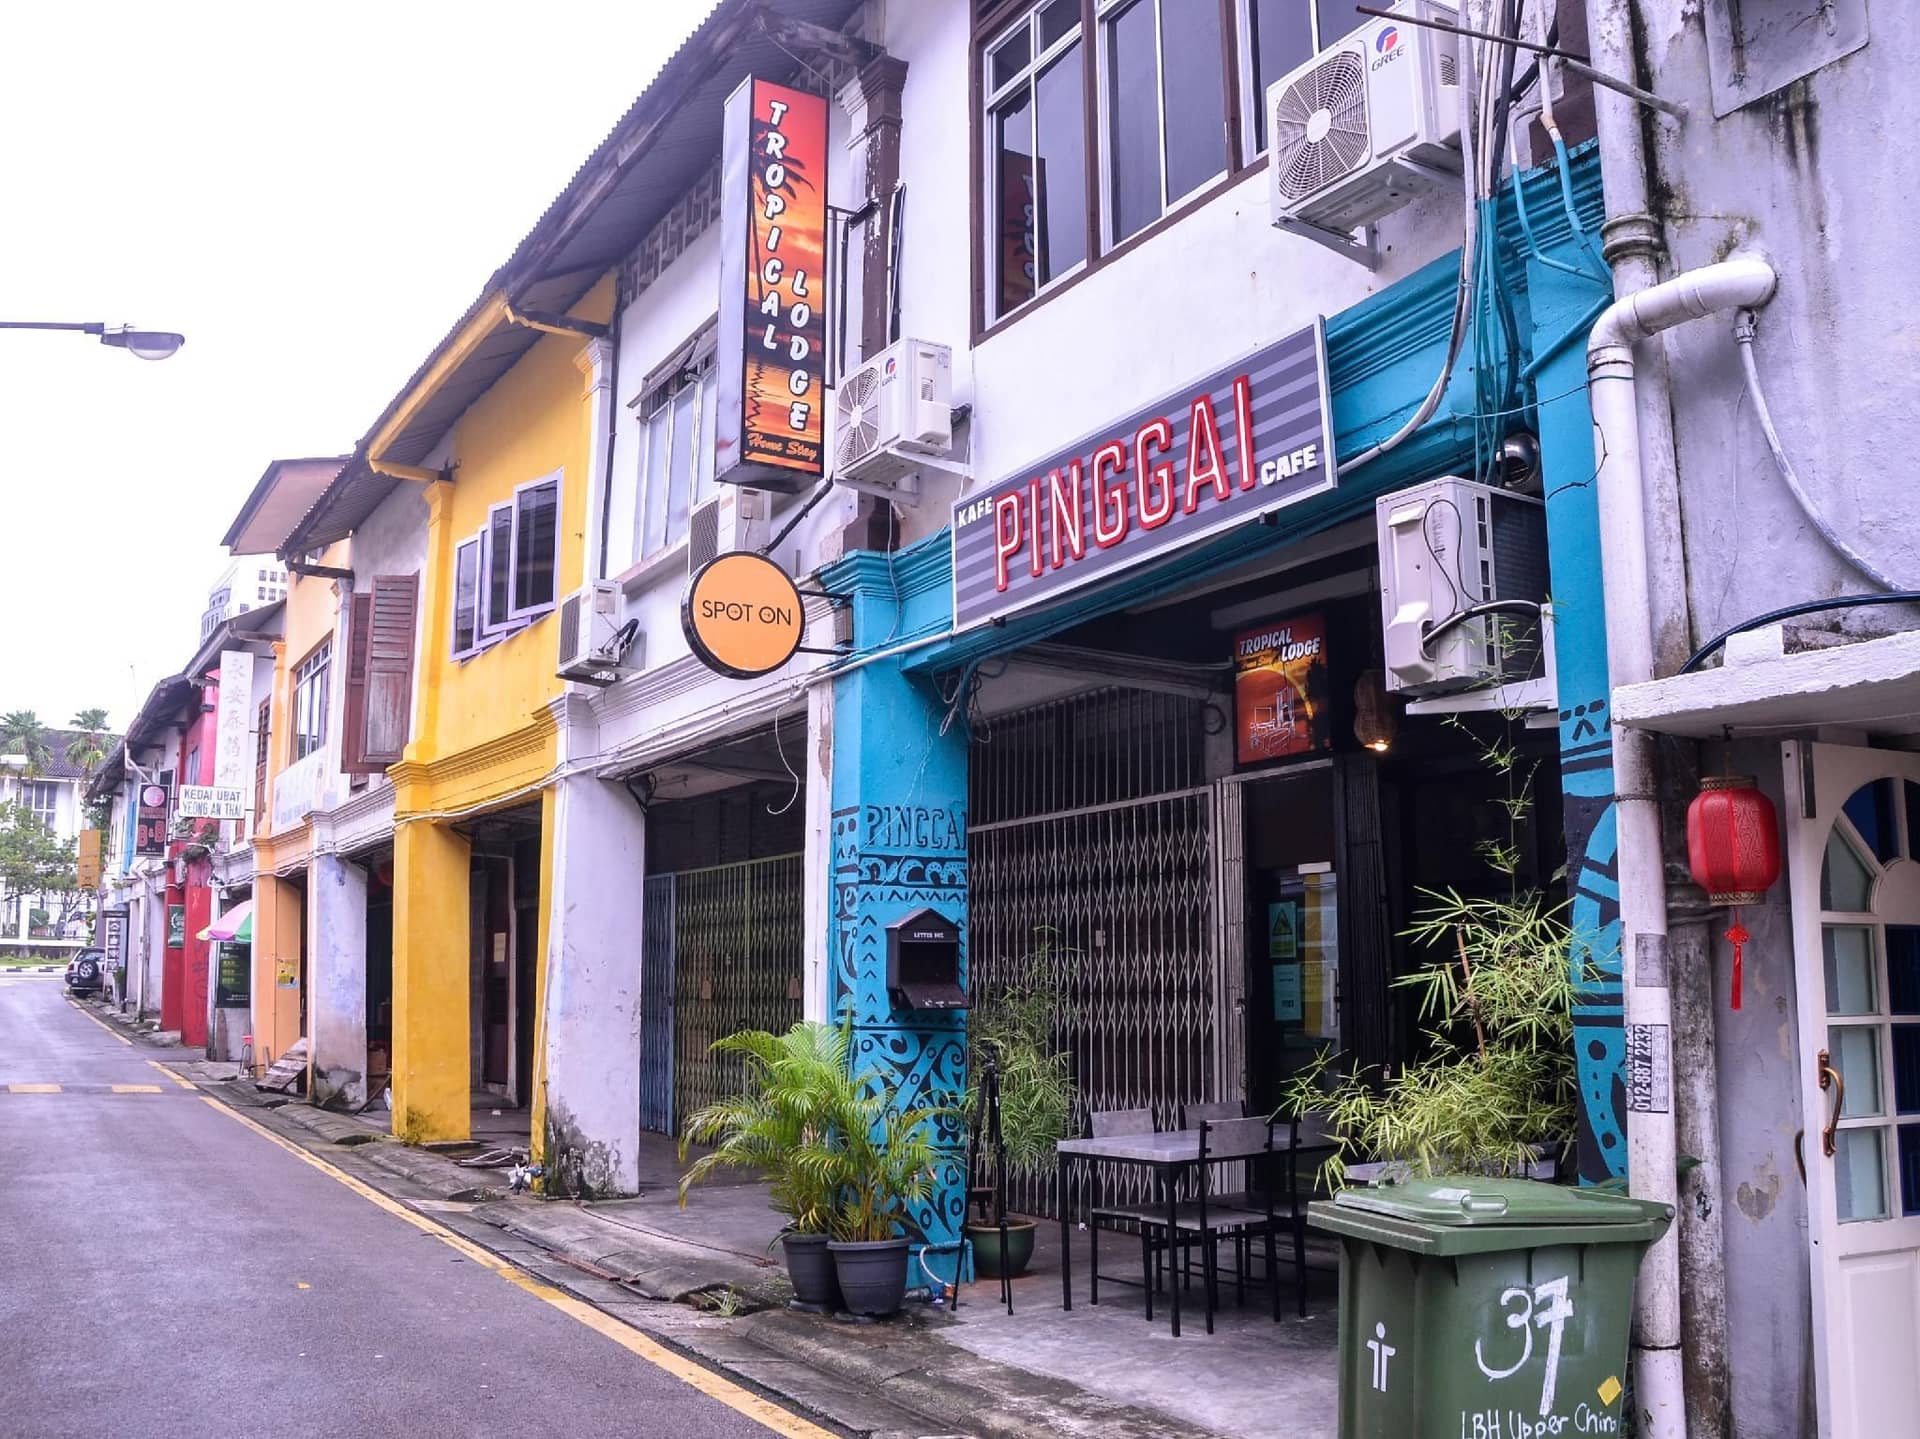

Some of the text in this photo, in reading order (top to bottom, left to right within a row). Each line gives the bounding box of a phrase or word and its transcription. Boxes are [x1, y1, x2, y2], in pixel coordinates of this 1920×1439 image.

[1371, 44, 1405, 72] GREE
[761, 101, 788, 350] TROPICAL
[789, 270, 811, 429] LODGE
[1260, 444, 1318, 487] CAFE
[993, 374, 1257, 592] PINGGAI
[958, 496, 993, 528] KAFE
[702, 600, 791, 626] SPOT ON
[1239, 627, 1293, 655] TROPICAL
[1281, 637, 1320, 662] LODGE
[184, 789, 241, 801] KEDAI UBAT
[211, 802, 222, 816] AN
[225, 803, 241, 816] THAI
[1634, 1025, 1651, 1057] 2232
[1475, 1275, 1573, 1415] 37
[1462, 1409, 1500, 1439] LBH
[1509, 1410, 1569, 1439] Upper
